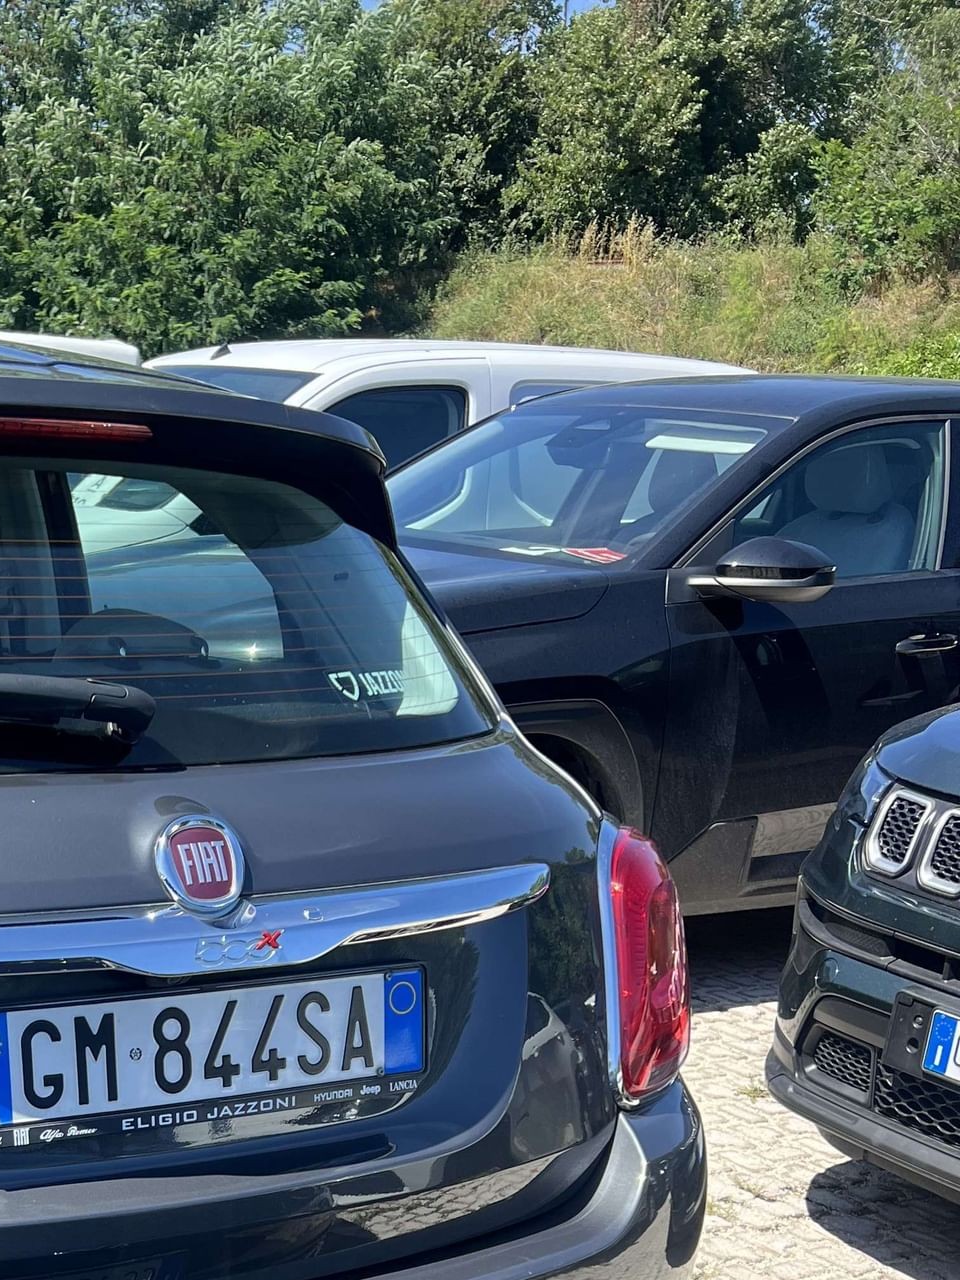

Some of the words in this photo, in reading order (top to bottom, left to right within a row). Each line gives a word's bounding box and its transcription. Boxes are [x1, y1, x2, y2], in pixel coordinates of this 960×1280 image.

[176, 840, 230, 886] FIAT
[20, 1013, 119, 1110] GM
[152, 986, 376, 1094] 844SA
[313, 1088, 353, 1103] HYUNDAI
[359, 1085, 381, 1095] Jeep
[389, 1080, 418, 1092] LANCIA
[121, 1110, 198, 1131] ELIGIO
[206, 1095, 296, 1119] JAZZONI
[12, 1127, 30, 1146] FIAT
[39, 1128, 64, 1142] Alfa
[66, 1125, 98, 1137] Romeo
